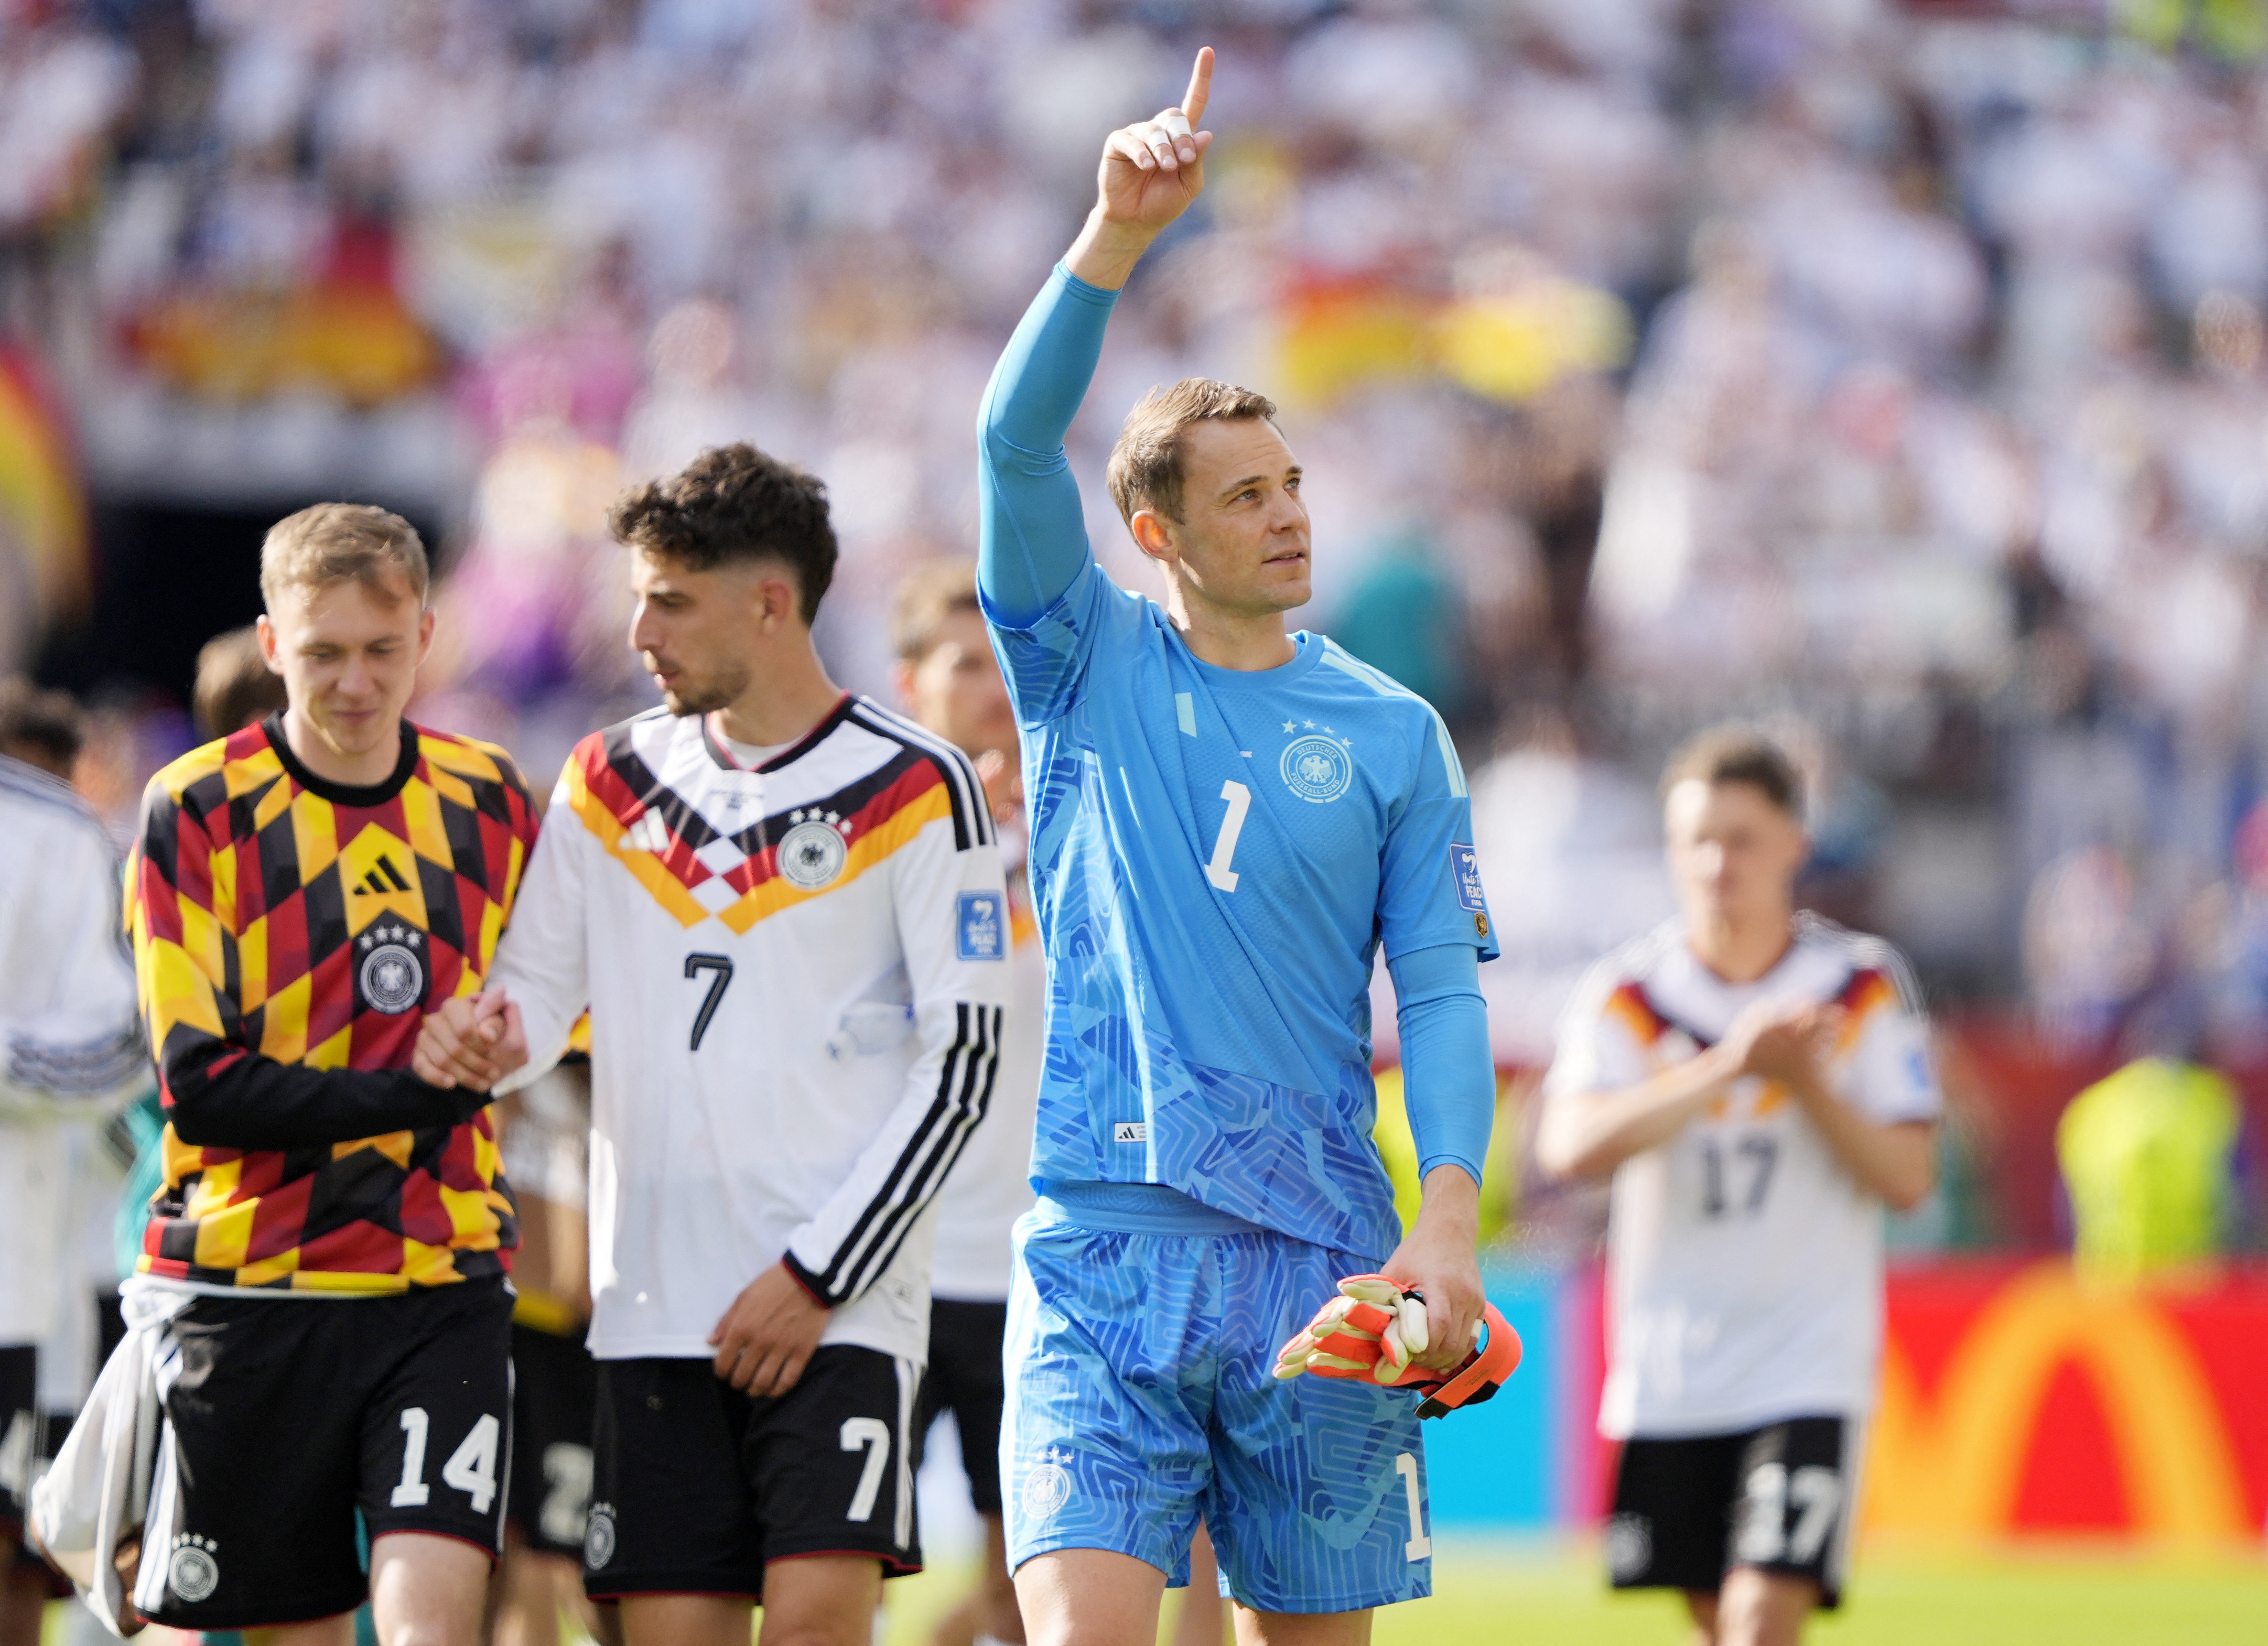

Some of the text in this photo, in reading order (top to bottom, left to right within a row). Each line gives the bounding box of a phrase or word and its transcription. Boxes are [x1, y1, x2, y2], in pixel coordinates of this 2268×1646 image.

[1290, 772, 1340, 794] FUSSBALL-BUND
[1297, 744, 1338, 760] DEUTSCHER
[1204, 779, 1251, 893] 1
[1466, 885, 1483, 898] PEAC
[684, 950, 734, 1051] 7
[1703, 1134, 1779, 1216] 17
[390, 1407, 500, 1515] 14
[840, 1416, 890, 1522] 7
[1396, 1452, 1432, 1562] 1
[1735, 1460, 1844, 1565] 17
